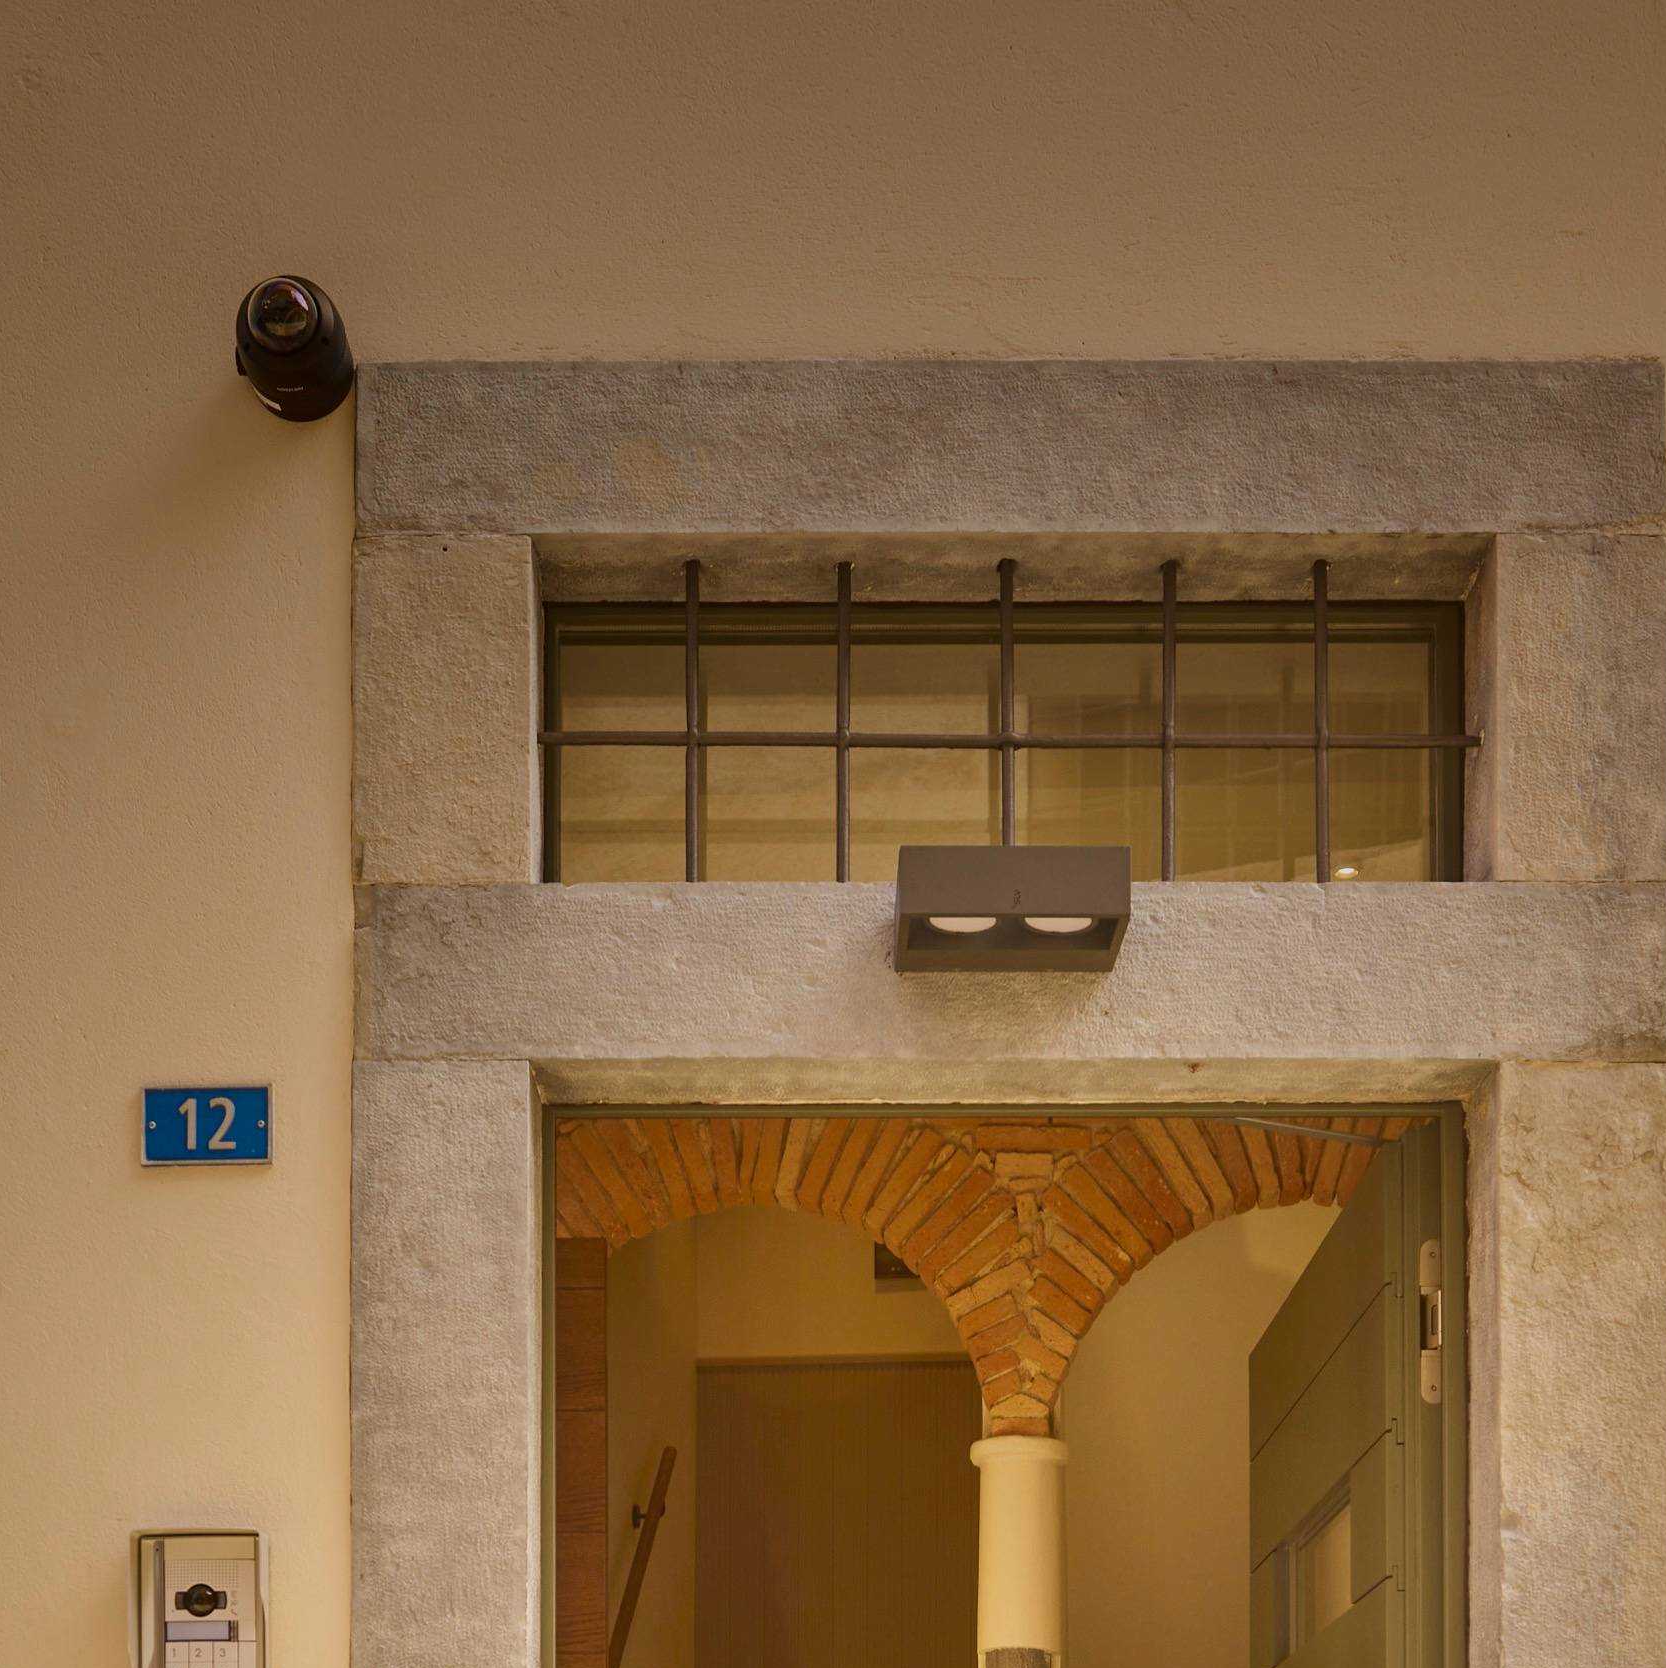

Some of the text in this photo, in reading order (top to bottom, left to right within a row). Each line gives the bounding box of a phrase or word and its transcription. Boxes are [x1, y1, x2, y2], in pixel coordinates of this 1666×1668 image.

[178, 1097, 237, 1150] 12
[195, 1648, 202, 1658] 2
[219, 1648, 226, 1658] 3
